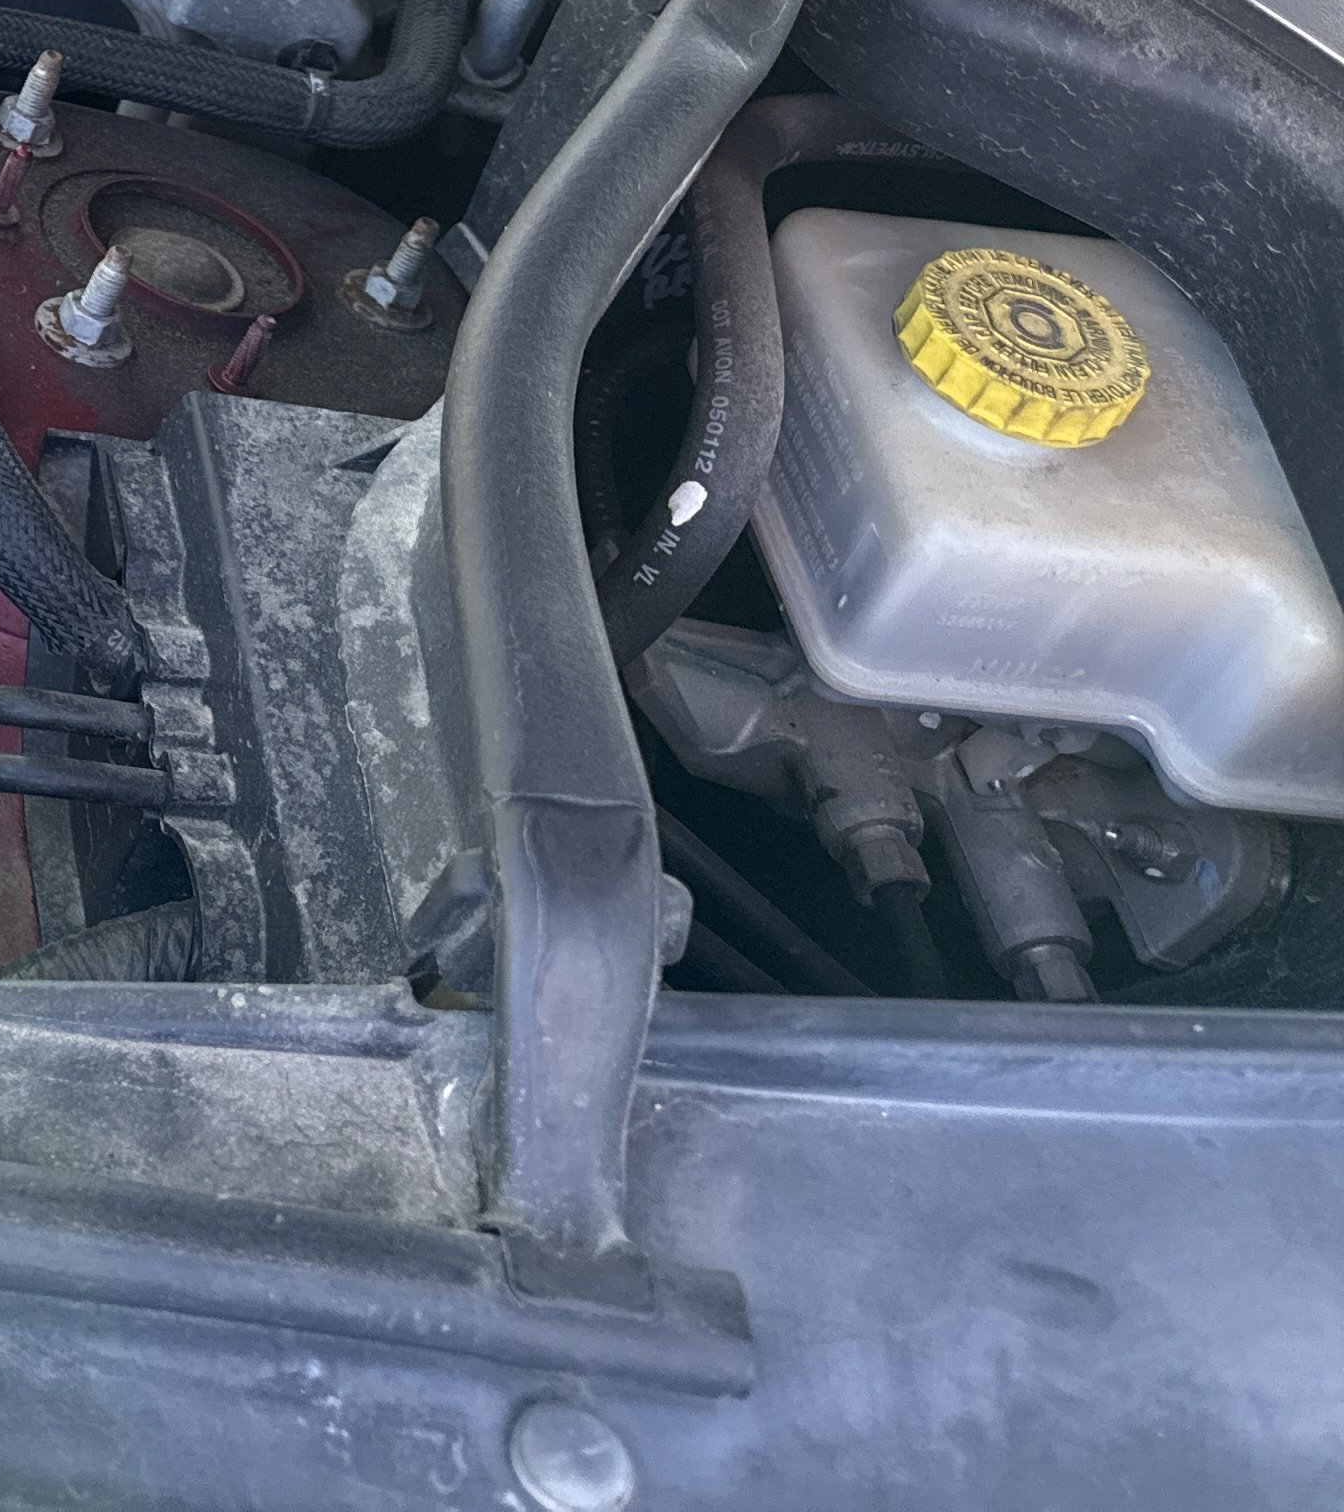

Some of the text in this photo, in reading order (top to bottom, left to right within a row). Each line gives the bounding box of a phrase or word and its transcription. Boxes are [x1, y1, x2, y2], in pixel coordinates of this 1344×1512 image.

[712, 299, 730, 328] DOT
[714, 337, 734, 384] AVON
[695, 394, 730, 475] 050112
